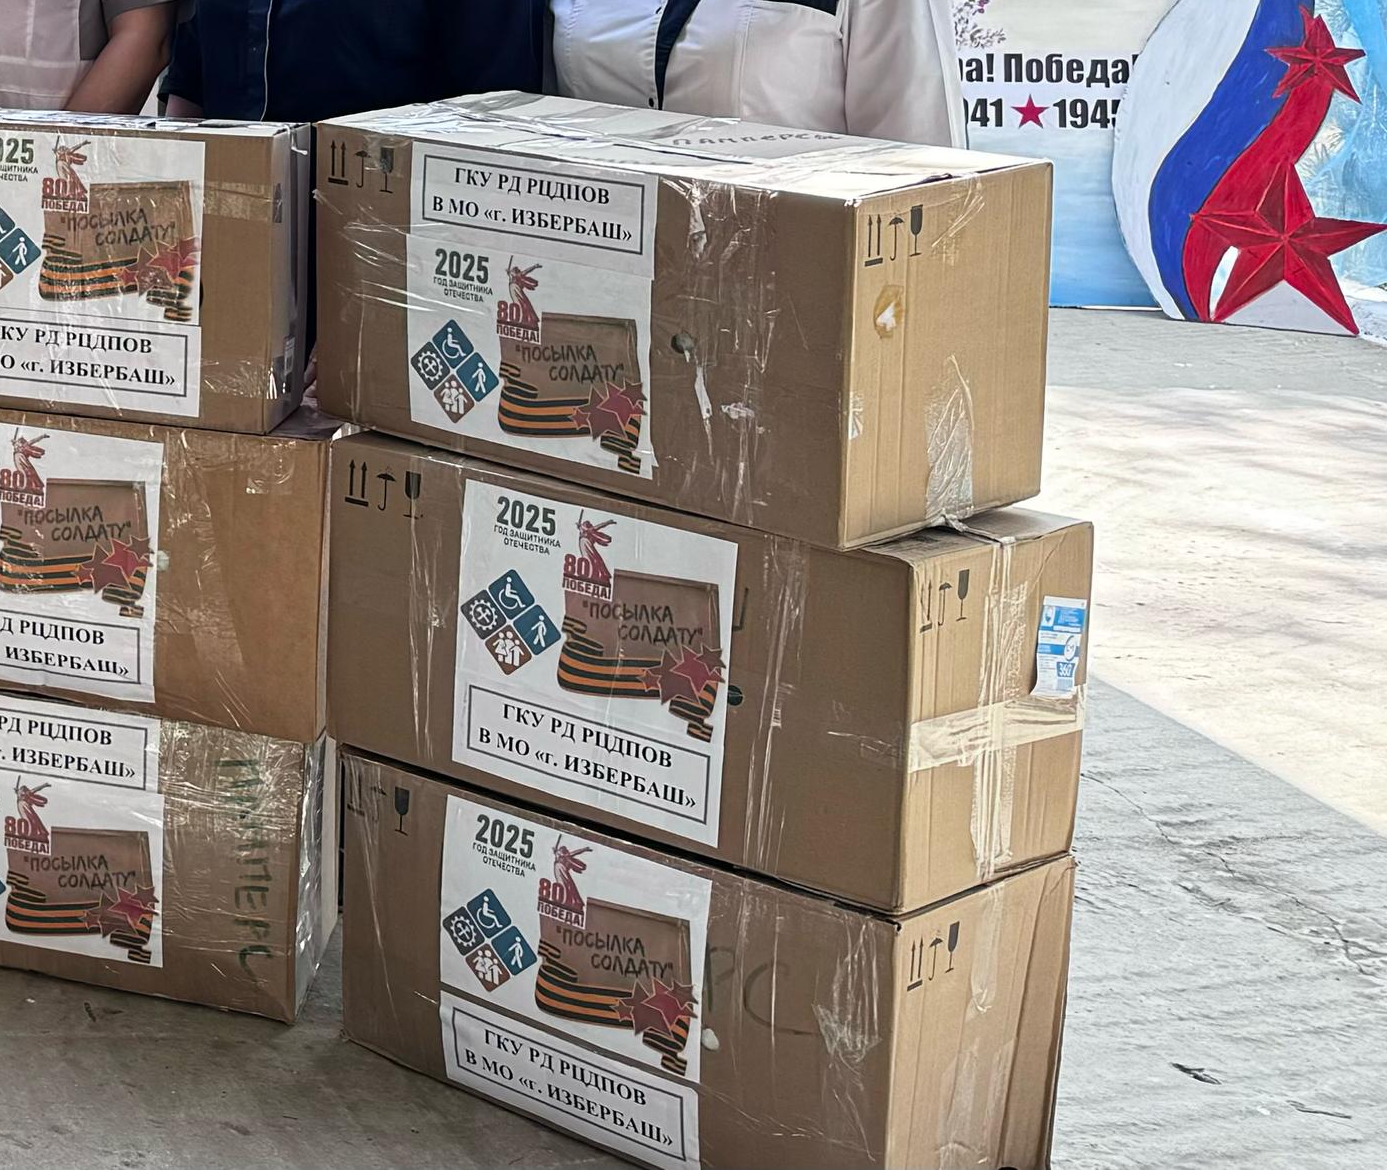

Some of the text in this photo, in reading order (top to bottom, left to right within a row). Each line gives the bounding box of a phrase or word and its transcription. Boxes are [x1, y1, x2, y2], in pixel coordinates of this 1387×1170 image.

[959, 54, 994, 83] а!
[964, 98, 1003, 128] 41
[455, 167, 610, 205] ГКУ РД РЦДПОВ
[435, 248, 489, 285] 2025
[21, 361, 44, 373] «г.
[50, 359, 176, 385] ИЗБЕРБАШ»
[496, 495, 557, 537] 2025
[493, 524, 561, 549] ГОД ЗАЩИТНИКА
[504, 536, 550, 556] ОТЕЧЕСТВА
[563, 553, 592, 581] 80
[20, 619, 105, 646] РЦДПОВ
[504, 703, 673, 768] ГКУ РД РЦДПОВ
[479, 727, 697, 808] В МО «г. ИЗБЕРБАШ»
[475, 814, 534, 859] 2025
